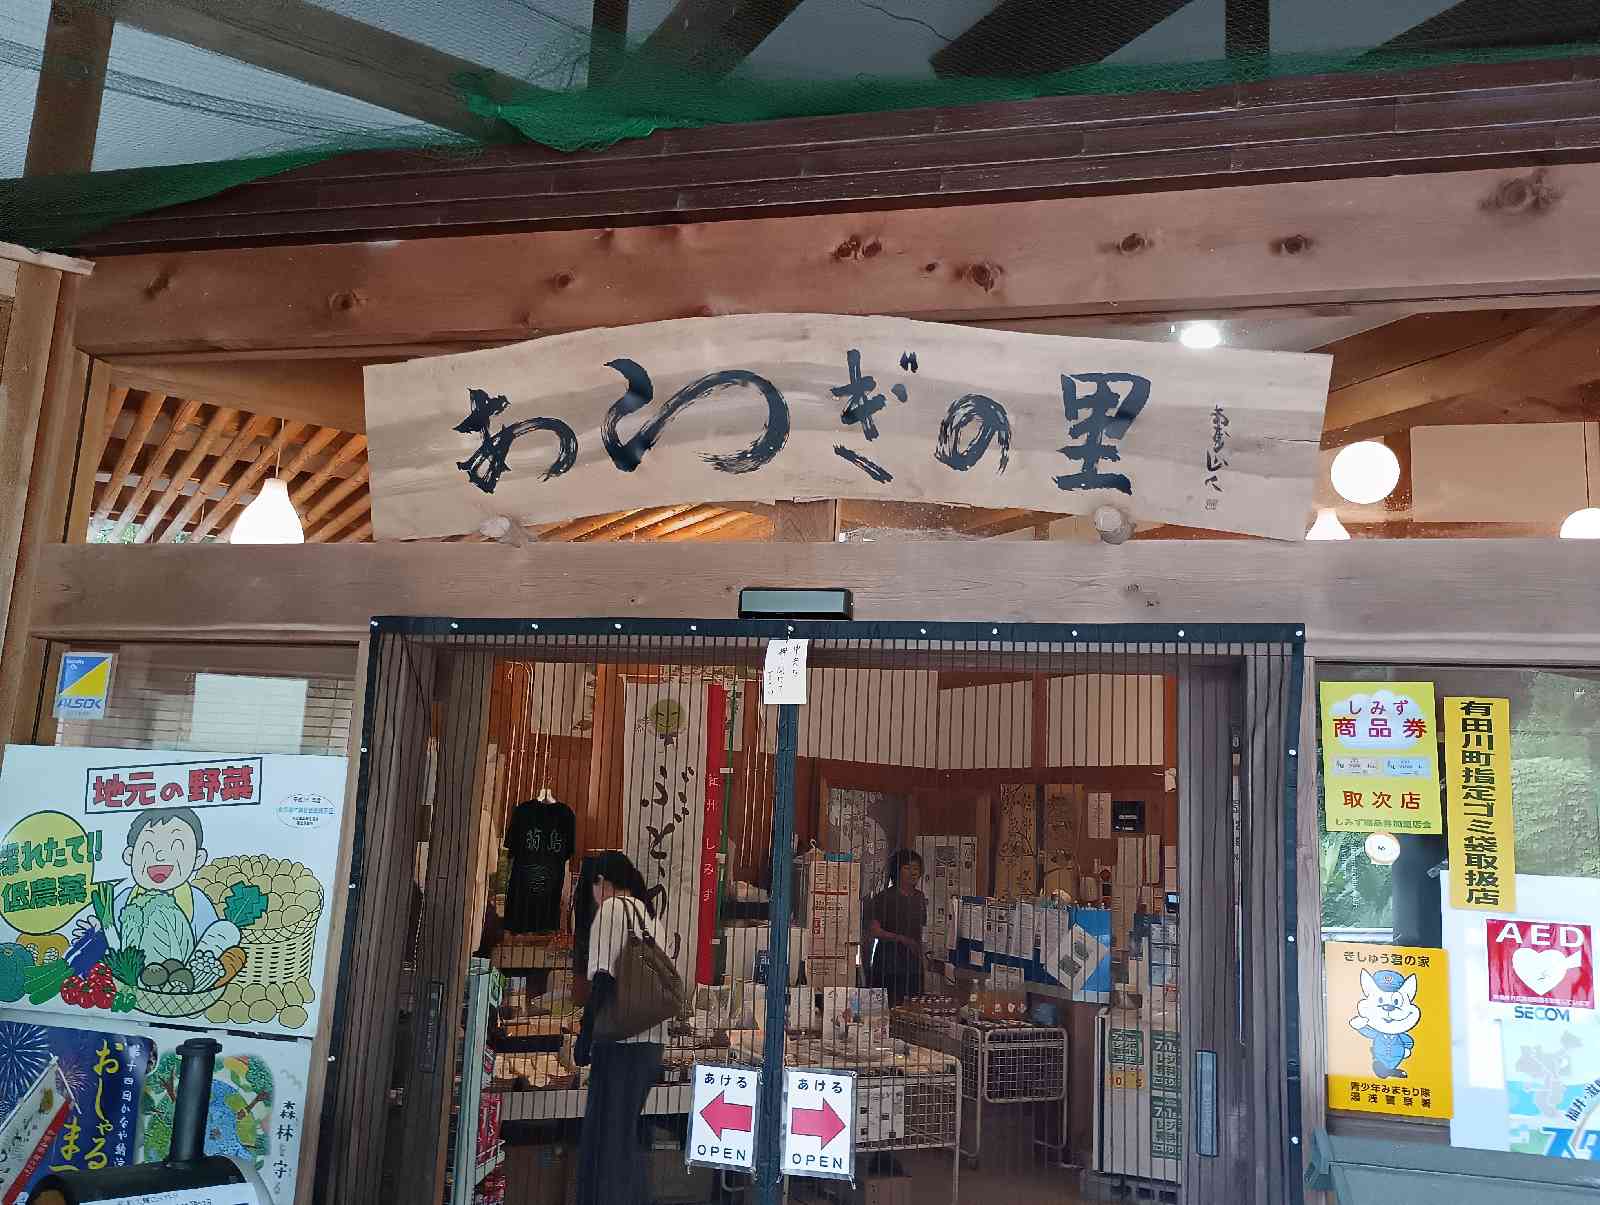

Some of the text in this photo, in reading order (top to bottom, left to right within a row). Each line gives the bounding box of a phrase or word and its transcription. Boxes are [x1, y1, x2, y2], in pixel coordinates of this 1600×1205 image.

[57, 698, 104, 710] ALSOK
[1348, 699, 1409, 716] しみず
[1332, 717, 1428, 739] 商品券
[92, 765, 255, 808] 地元の野菜
[1342, 790, 1421, 810] 取次店
[1495, 921, 1585, 949] AED
[1514, 1005, 1570, 1022] SECOM
[704, 1072, 748, 1089] あける
[797, 1077, 844, 1094] あける
[697, 1144, 747, 1161] OPEN
[792, 1153, 843, 1170] OPEN
